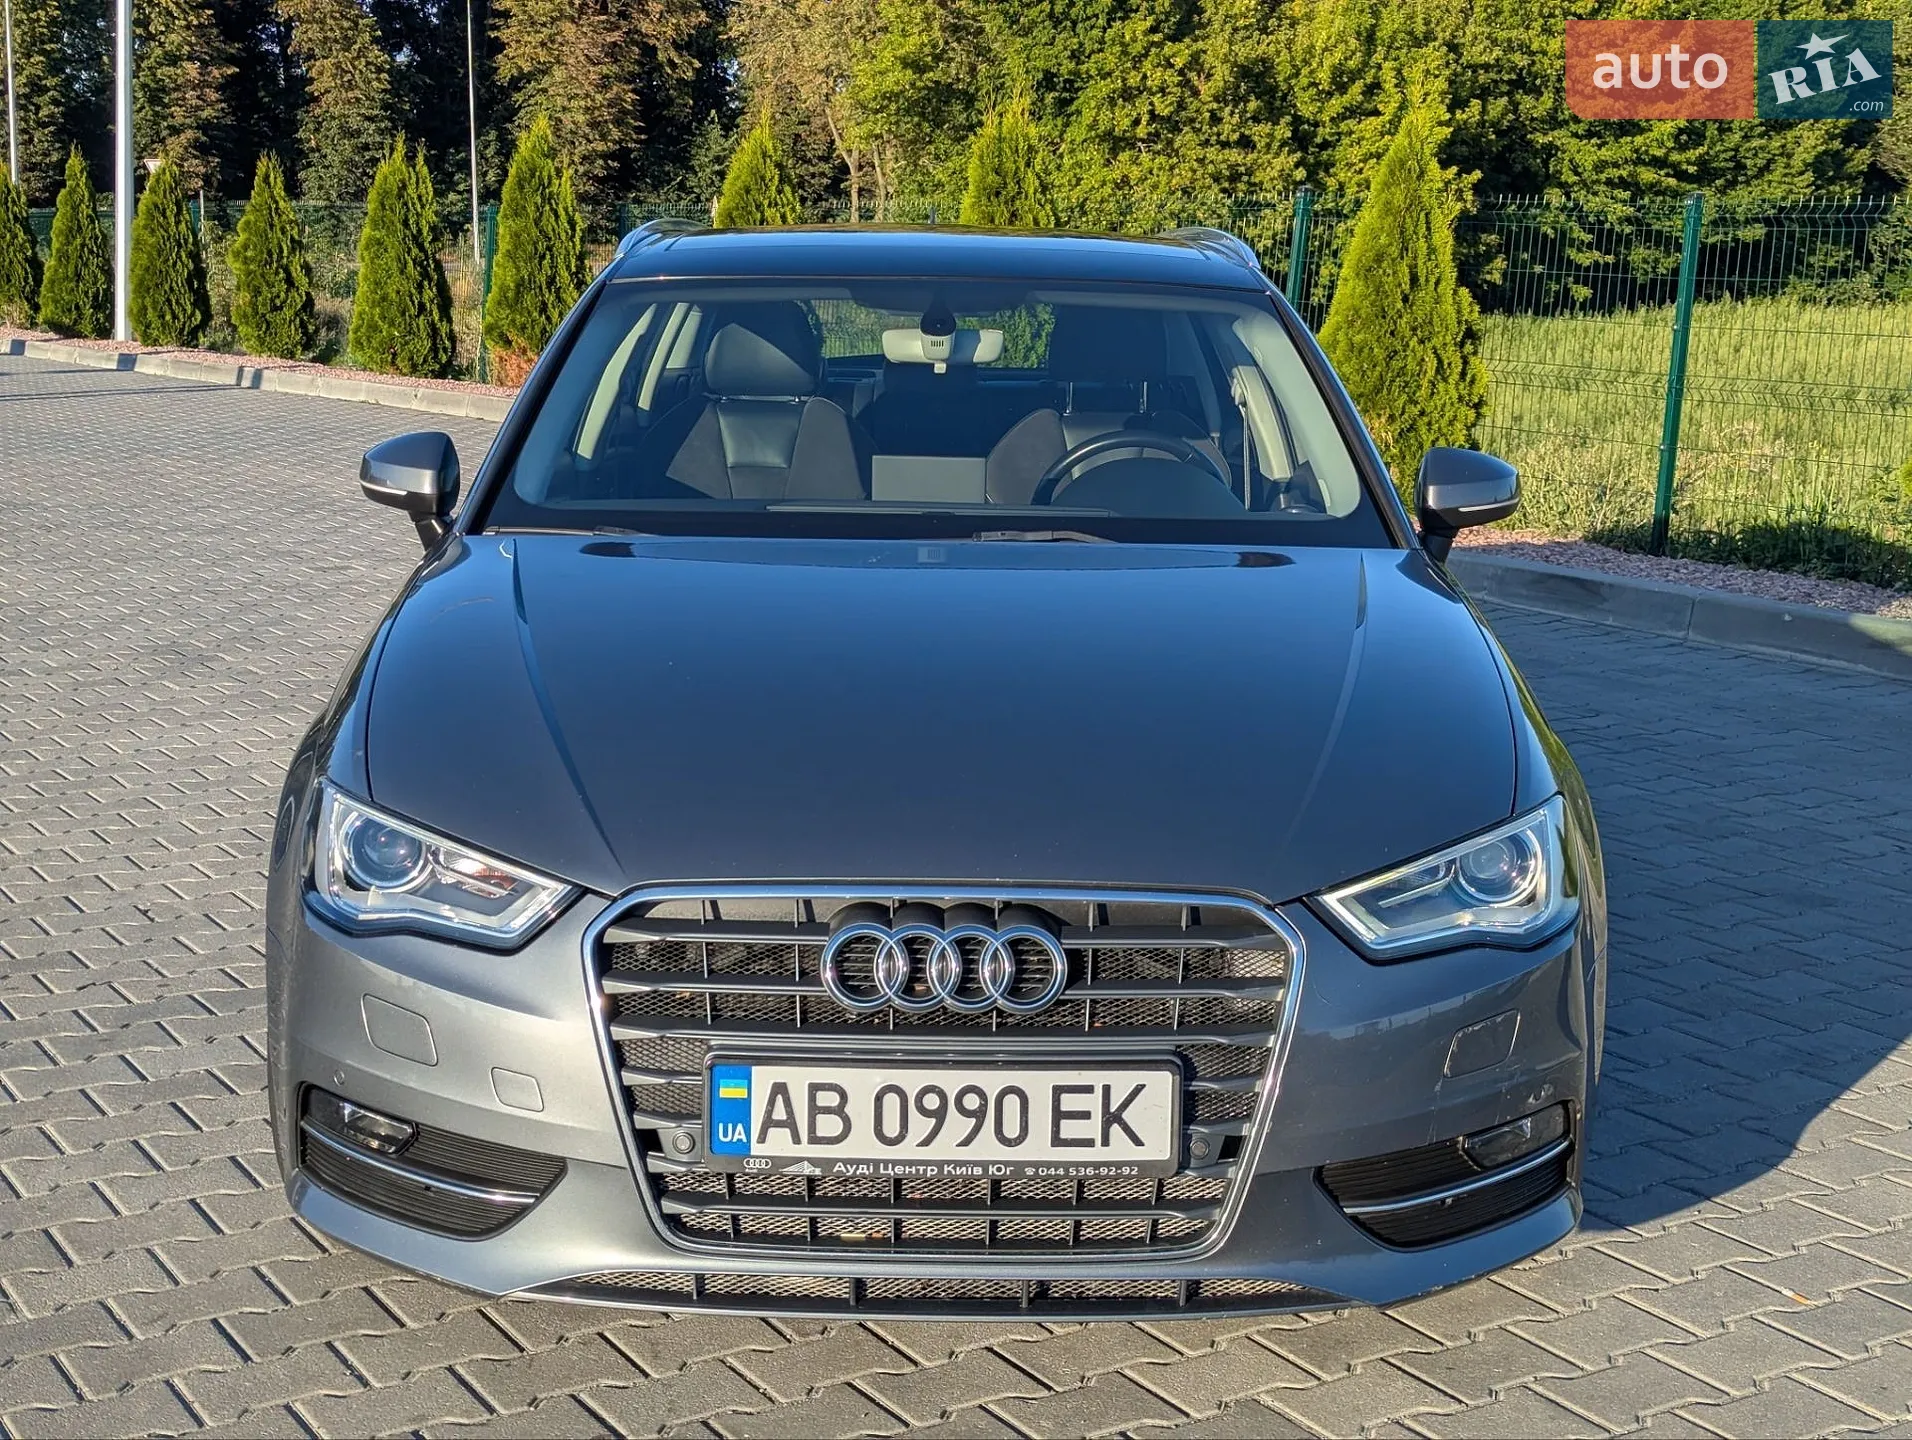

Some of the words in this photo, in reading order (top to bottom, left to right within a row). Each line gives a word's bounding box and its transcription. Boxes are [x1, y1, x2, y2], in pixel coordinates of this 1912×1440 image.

[756, 1081, 852, 1147] AB
[873, 1083, 1030, 1148] 0990
[1050, 1083, 1147, 1148] EK
[718, 1122, 747, 1143] UA
[833, 1161, 874, 1176] Ауді
[879, 1163, 938, 1177] Центр
[944, 1162, 982, 1176] Київ
[988, 1164, 1015, 1176] Юг
[1038, 1167, 1065, 1176] 044
[1069, 1166, 1139, 1176] 536-92-92
